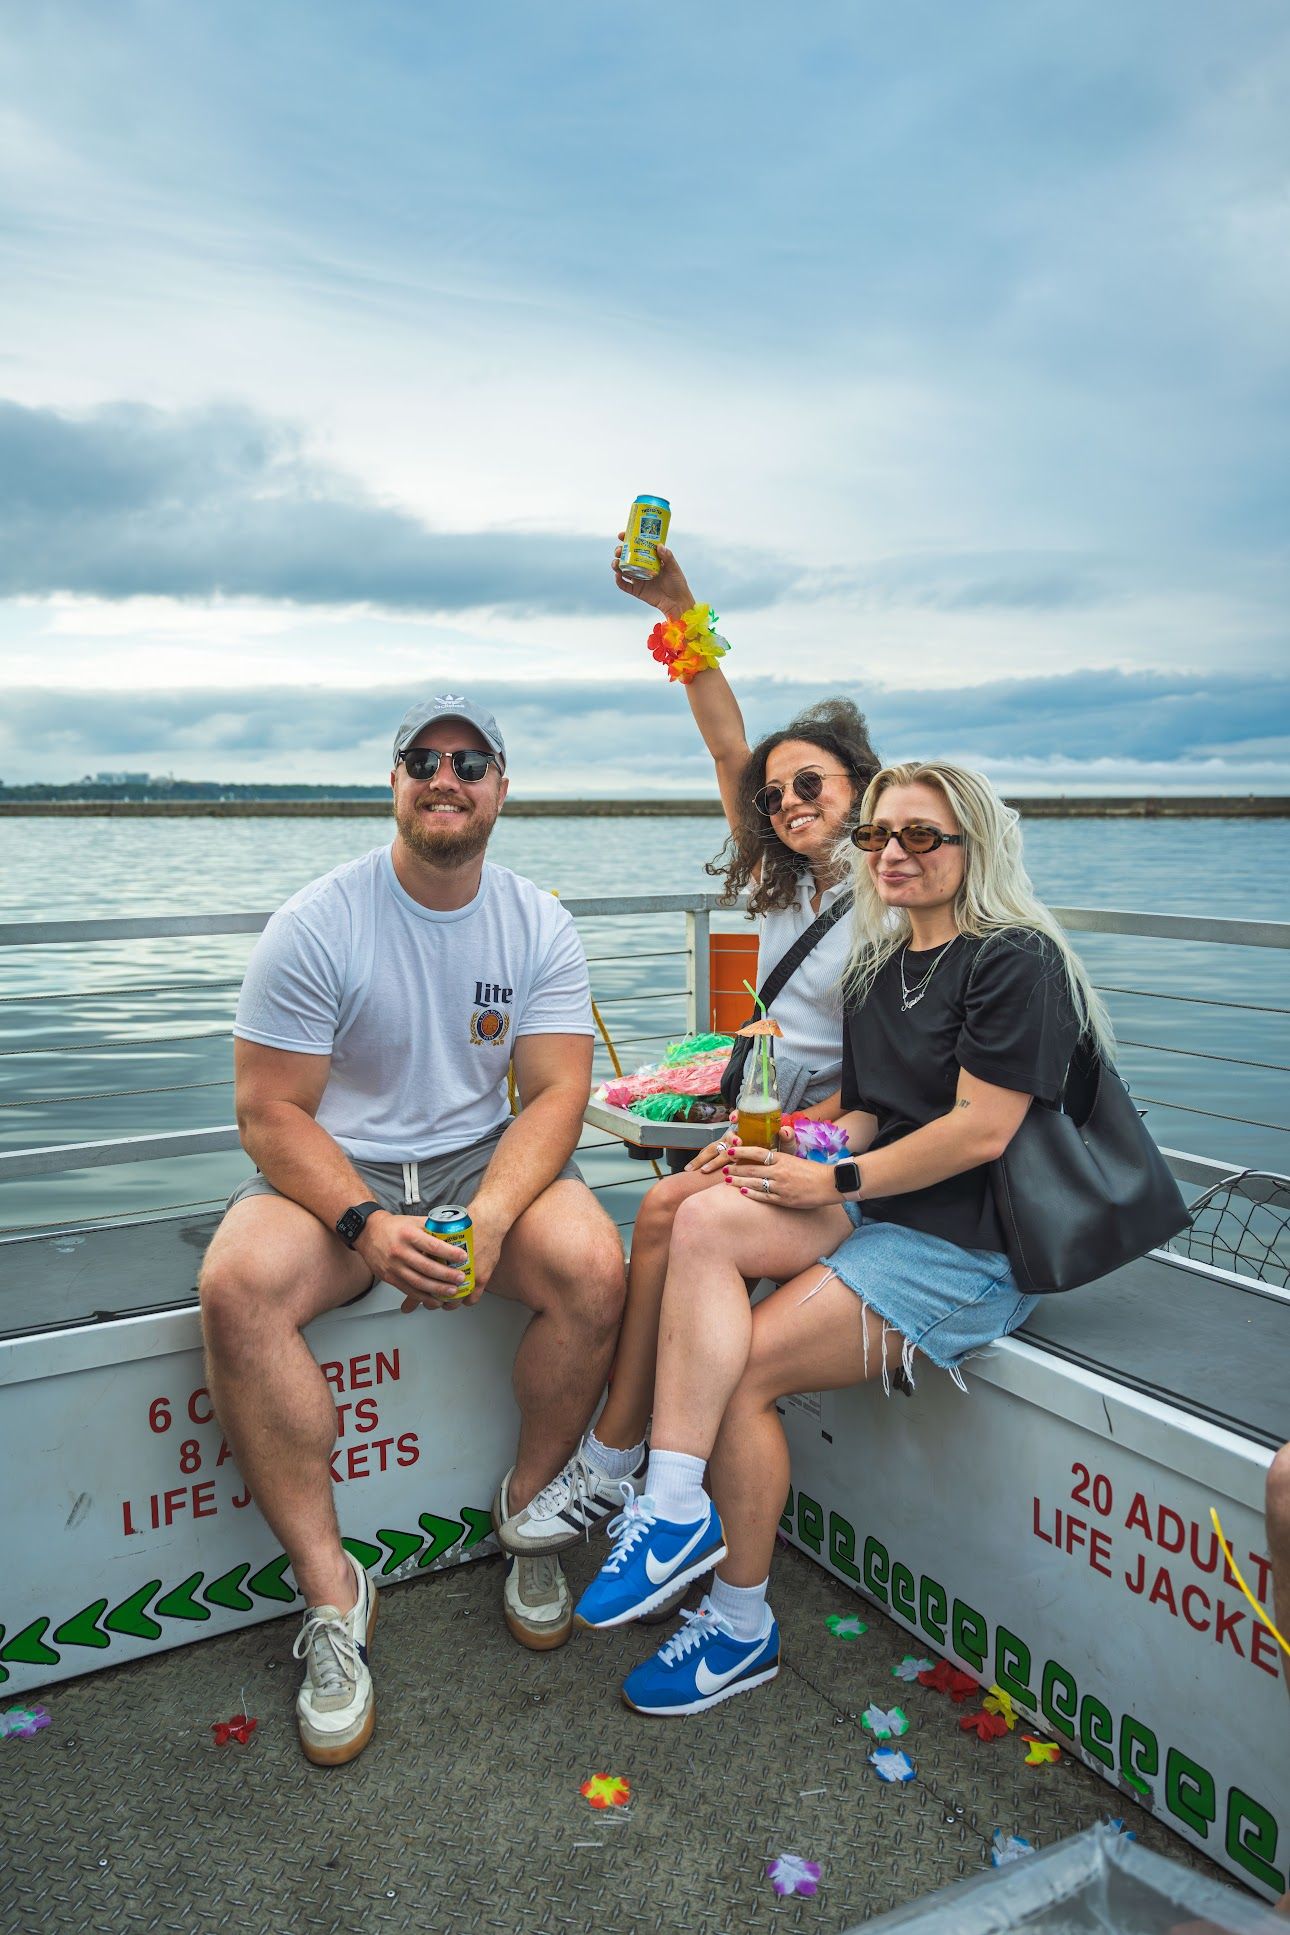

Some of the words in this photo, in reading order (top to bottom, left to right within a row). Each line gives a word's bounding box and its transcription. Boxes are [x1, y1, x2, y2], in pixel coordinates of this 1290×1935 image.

[473, 981, 513, 1008] Lite
[149, 1397, 172, 1434] 6
[179, 1439, 202, 1474] 8
[123, 1480, 217, 1535] LIFE
[232, 1432, 420, 1508] JKETS
[1071, 1462, 1113, 1517] 20
[1033, 1496, 1112, 1578] LIFE
[1125, 1554, 1279, 1678] JACKE
